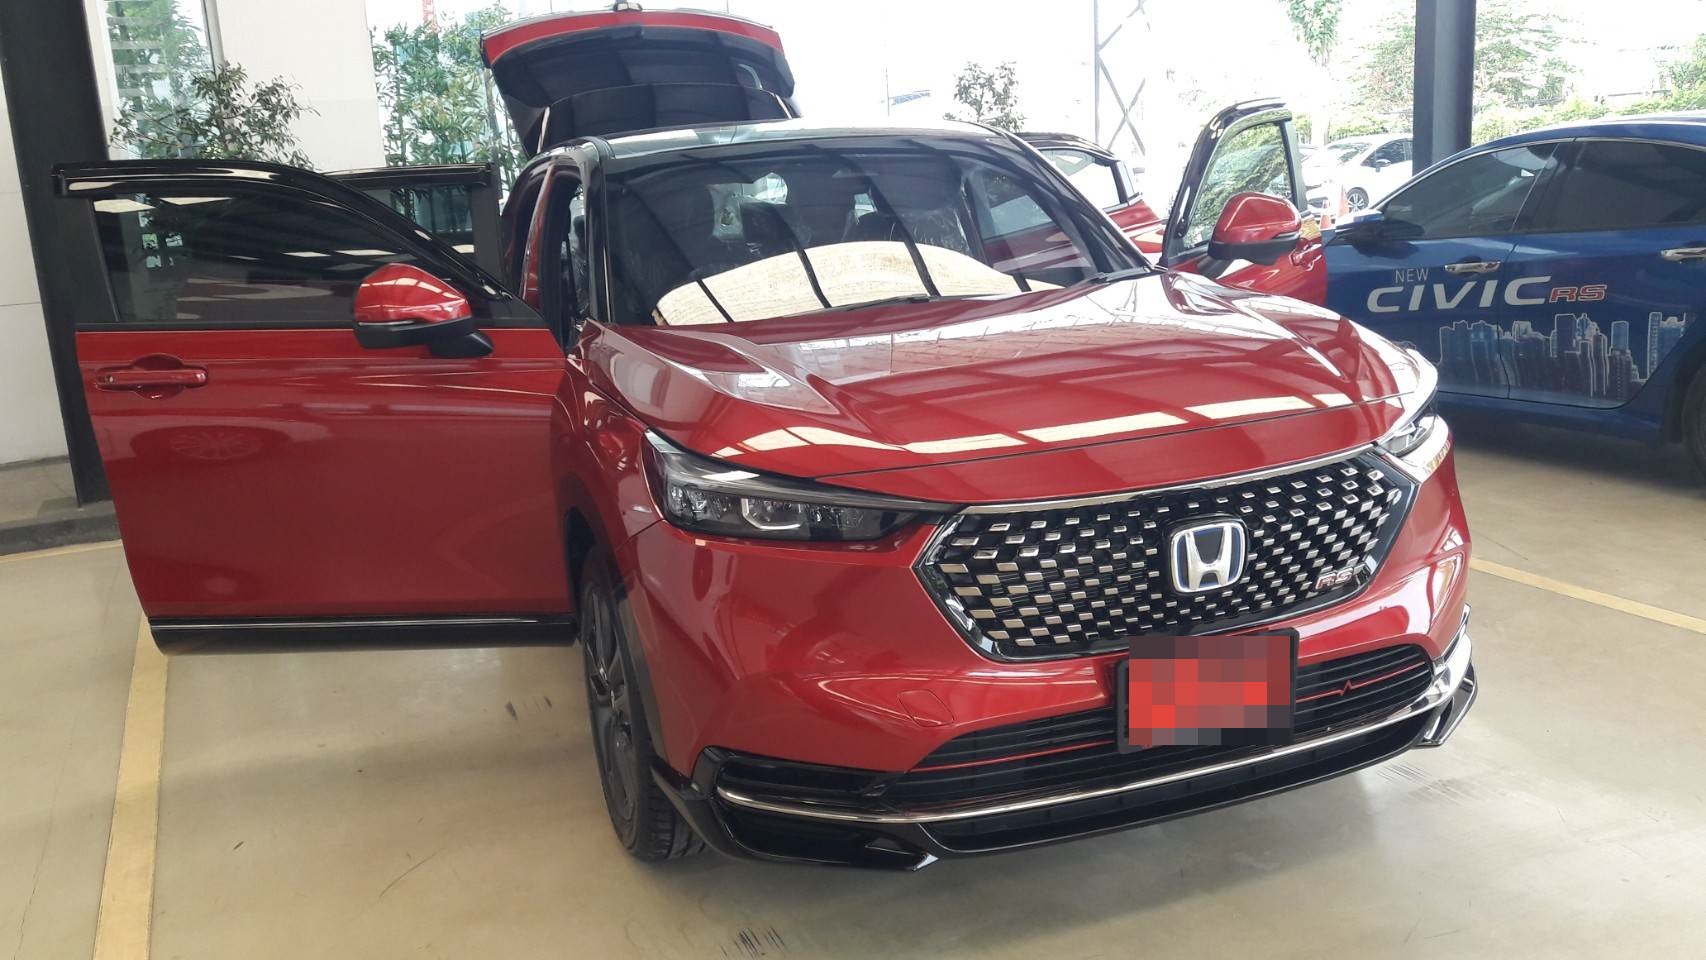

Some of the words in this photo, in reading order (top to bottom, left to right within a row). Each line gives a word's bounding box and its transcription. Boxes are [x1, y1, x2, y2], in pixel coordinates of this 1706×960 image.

[1395, 268, 1429, 283] NEW
[1367, 276, 1551, 313] CIVIC
[1548, 284, 1608, 303] RS
[1315, 567, 1354, 590] RS
